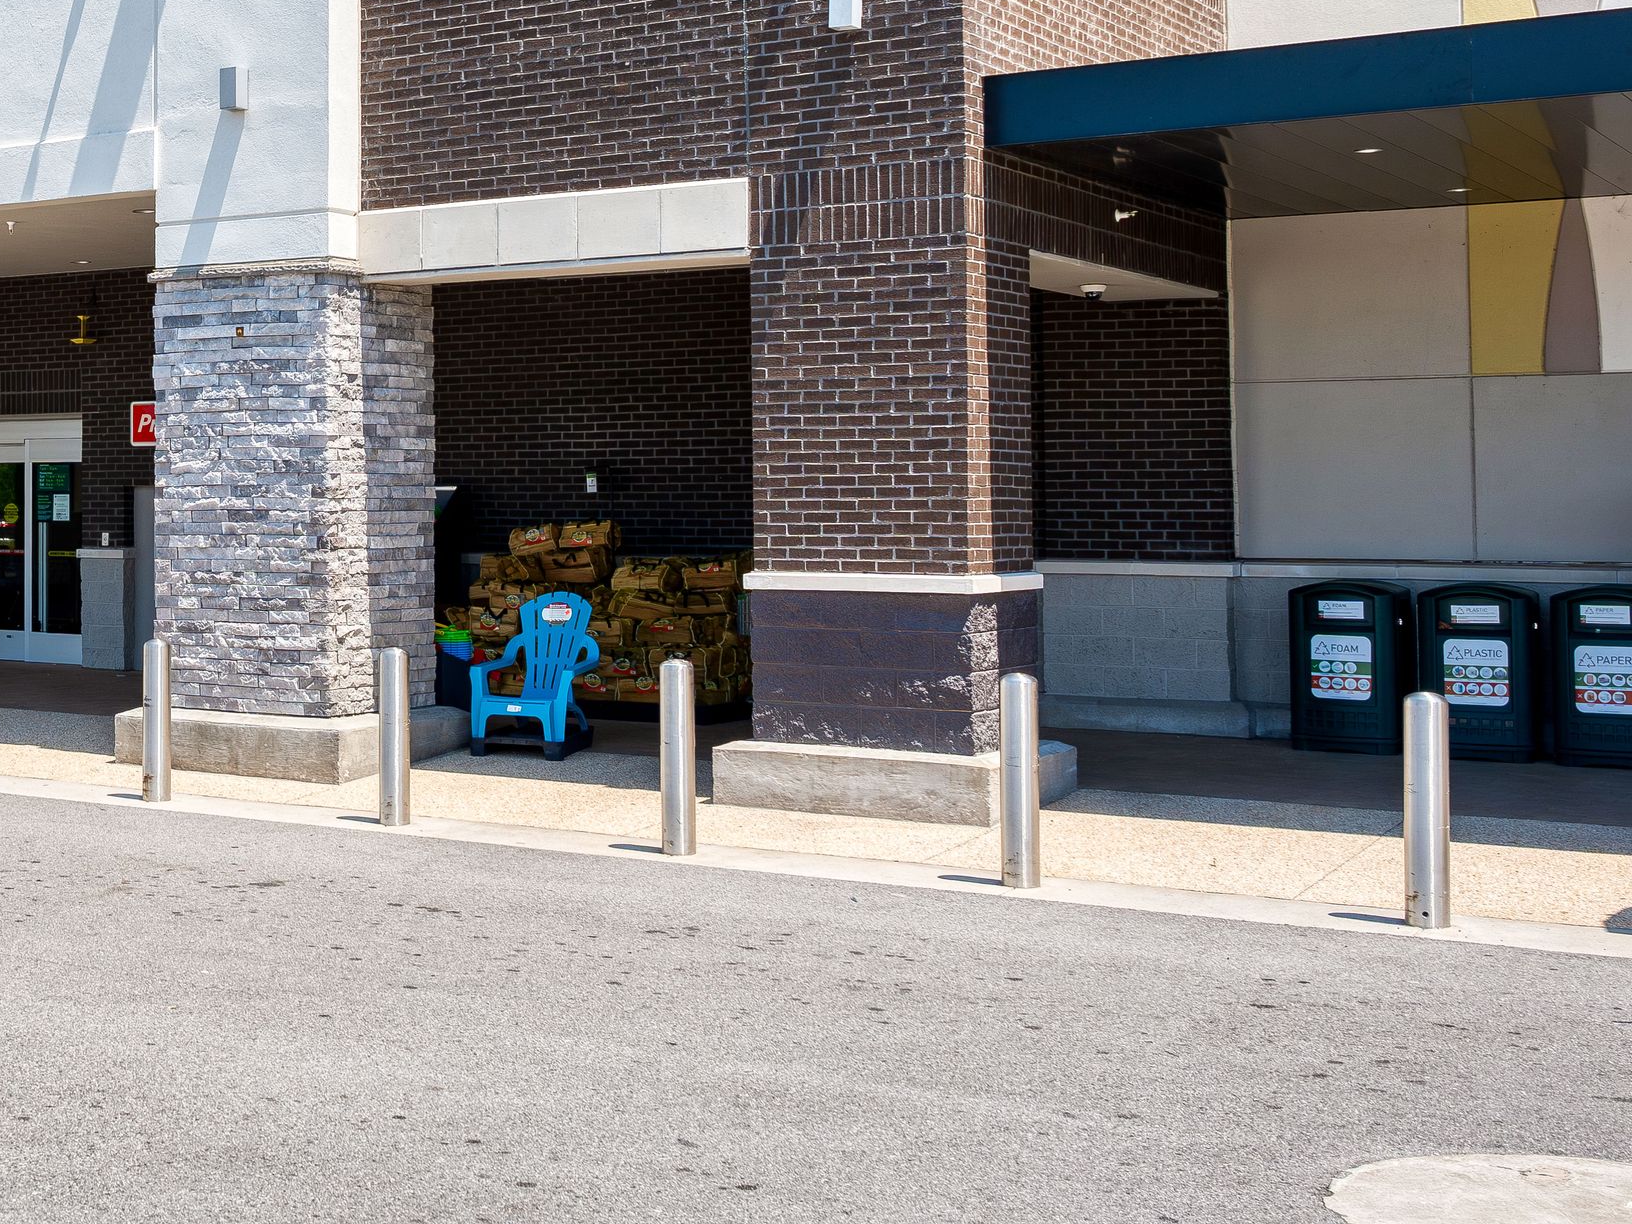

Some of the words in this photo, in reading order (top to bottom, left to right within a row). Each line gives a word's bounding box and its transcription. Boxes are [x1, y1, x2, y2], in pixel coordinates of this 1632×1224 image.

[1330, 643, 1359, 653] FOAM
[1464, 648, 1503, 658] PLASTIC
[1596, 655, 1632, 665] PAPER
